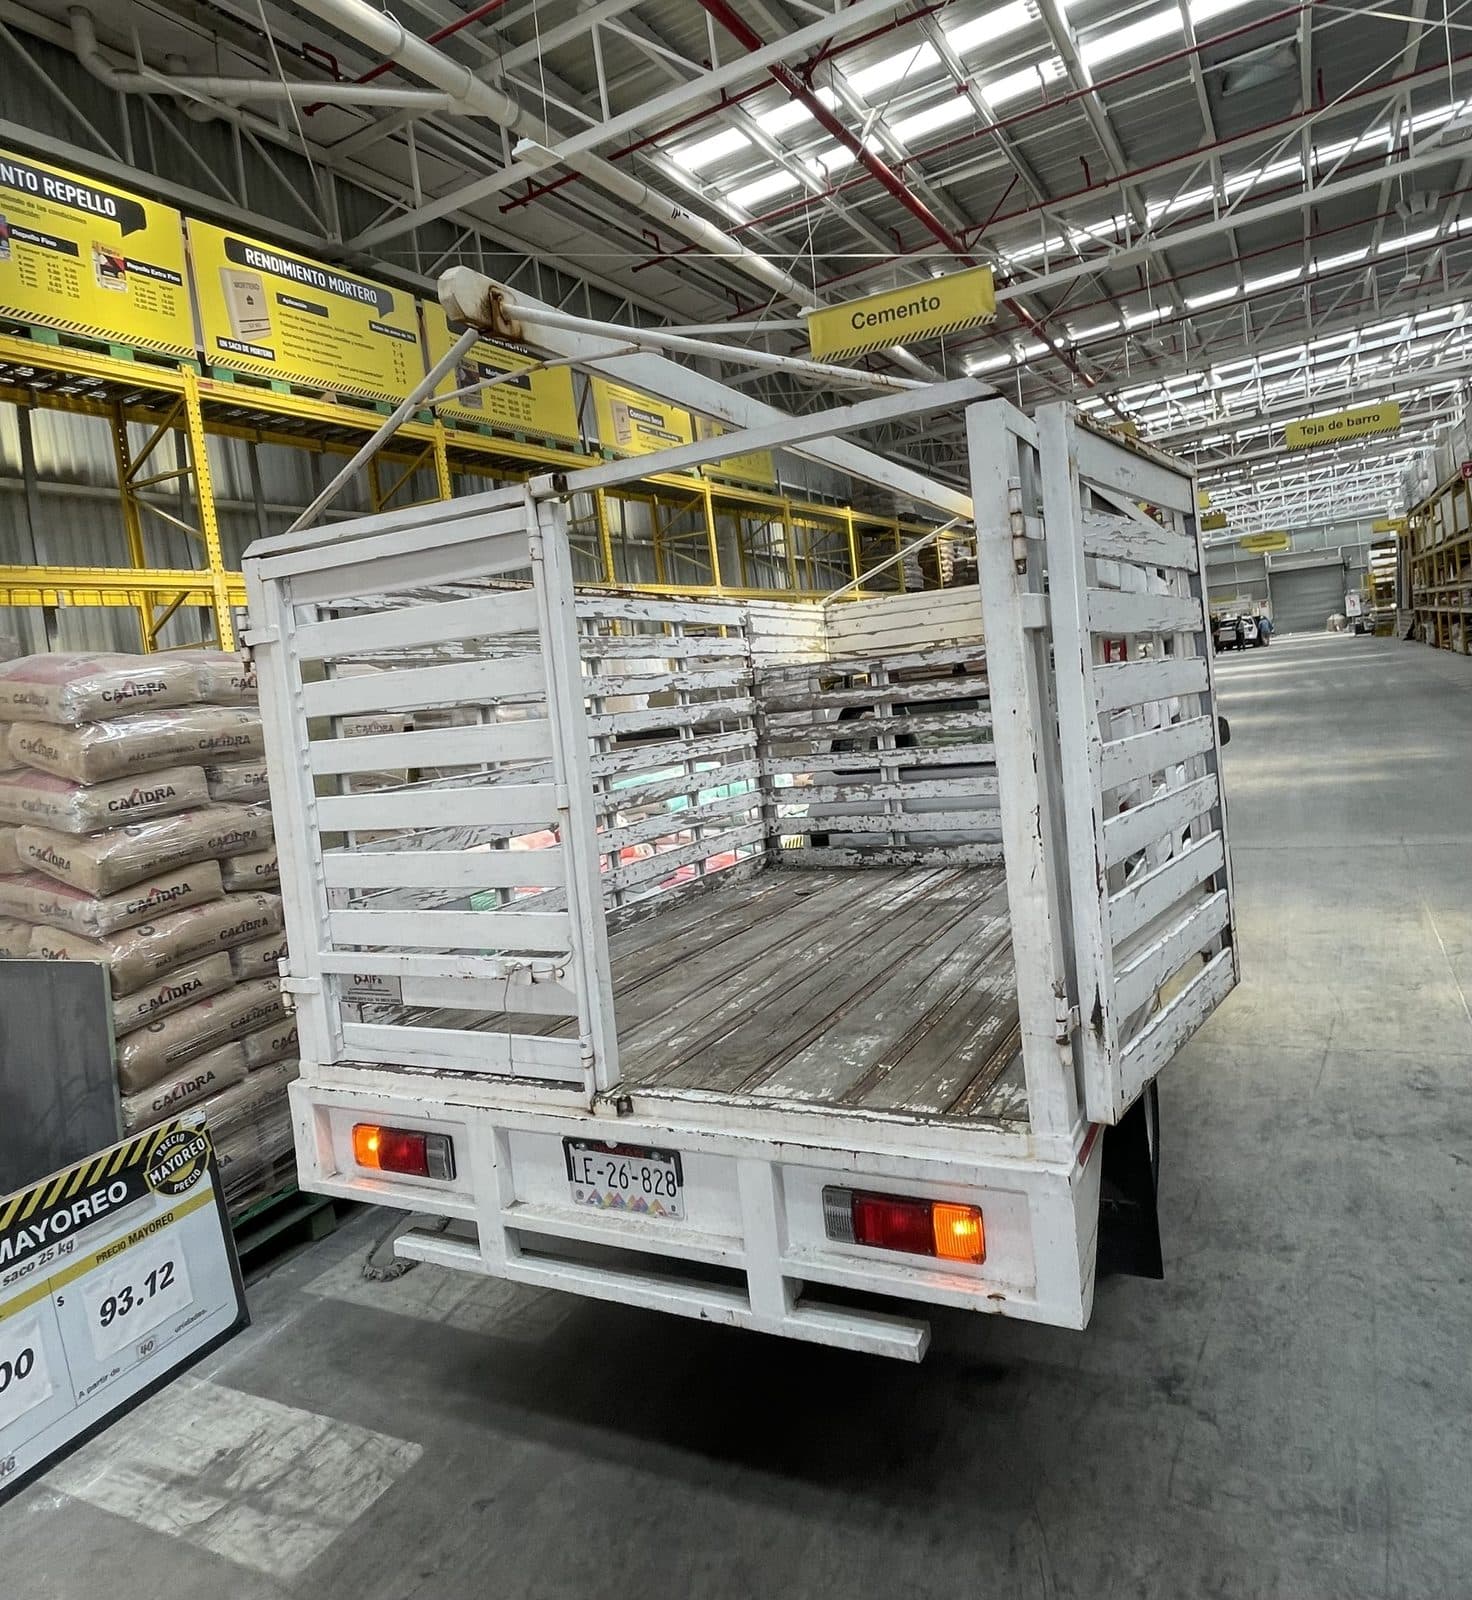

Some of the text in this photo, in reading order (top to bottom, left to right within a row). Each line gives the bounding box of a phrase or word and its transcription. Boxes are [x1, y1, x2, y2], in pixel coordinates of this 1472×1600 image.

[43, 177, 117, 217] REPELLO
[245, 248, 377, 304] RENDIMIENTO MORTERO
[851, 296, 941, 330] Cemento
[1300, 414, 1380, 436] Teja de barro
[199, 734, 251, 750] CALIDRA
[109, 786, 176, 812] CALIDRA
[29, 845, 71, 870] CALIDRA
[126, 882, 192, 915] CALIDRA
[219, 917, 268, 940] CALIDRA
[138, 978, 202, 1015] CALIDRA
[152, 1070, 216, 1112] CALIDRA
[149, 1138, 206, 1185] MAYOREO
[156, 1133, 185, 1157] PRECIO
[173, 1168, 201, 1193] PRECIO
[572, 1156, 677, 1198] LE-26-828
[0, 1181, 128, 1265] MAYOREO
[96, 1212, 174, 1264] PRECIO MAYOREO
[3, 1239, 74, 1287] saco 25 kg
[100, 1261, 175, 1327] 93.12
